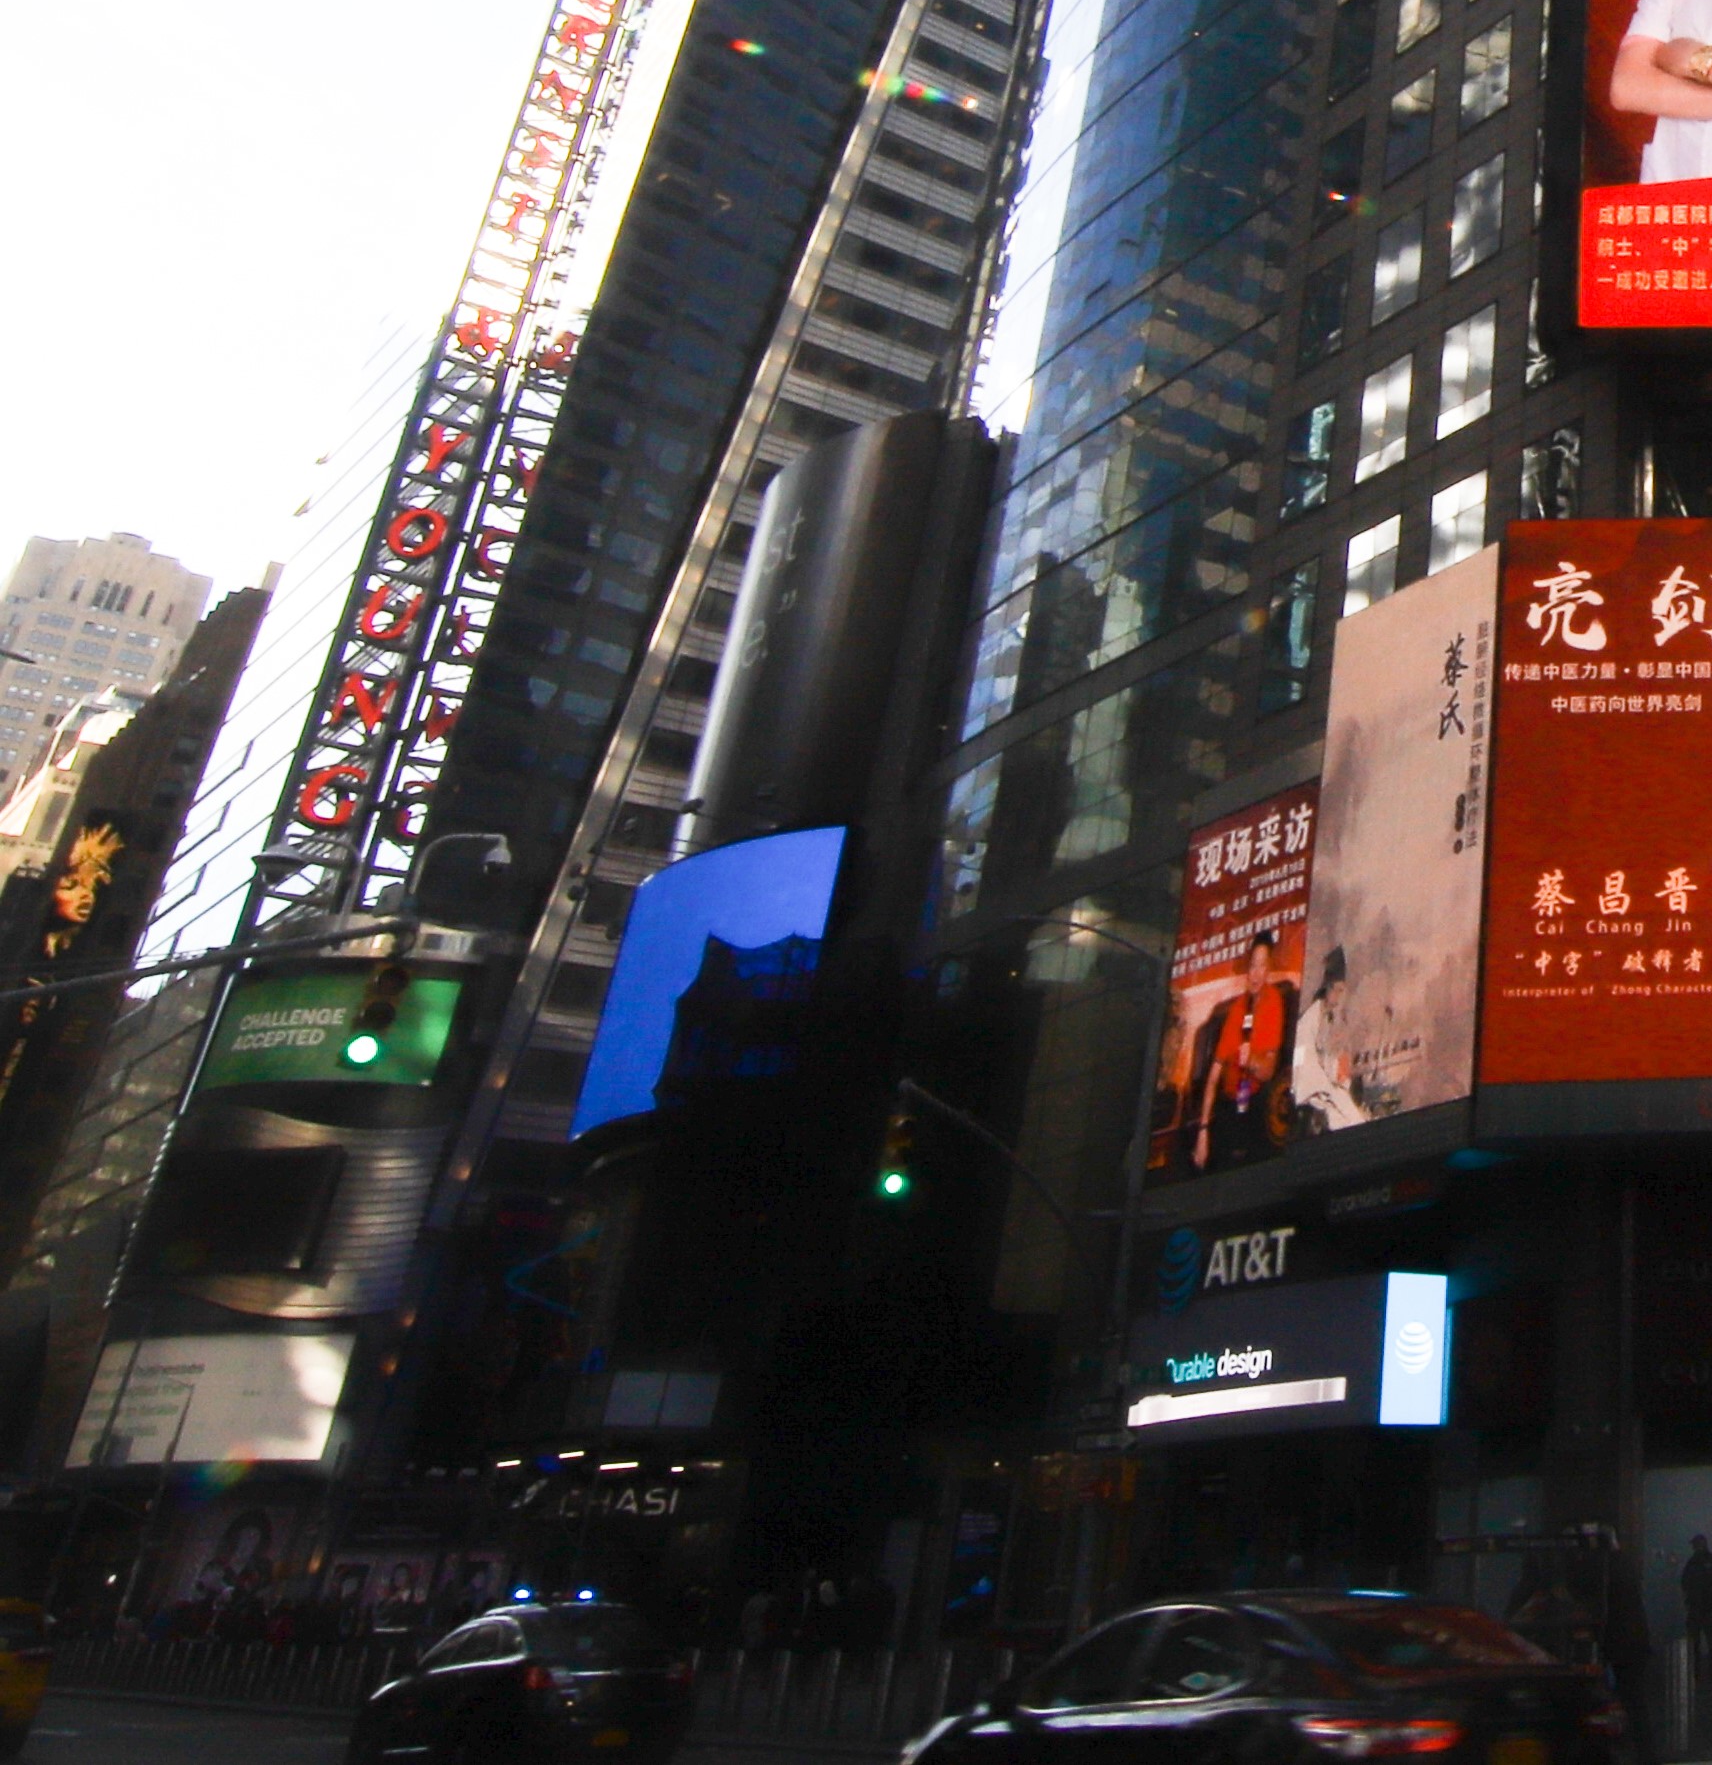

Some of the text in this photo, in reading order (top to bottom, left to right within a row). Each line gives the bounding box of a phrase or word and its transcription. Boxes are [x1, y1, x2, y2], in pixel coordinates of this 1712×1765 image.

[299, 422, 469, 826] YOUNG
[1194, 802, 1313, 887] 现场采访
[1531, 867, 1699, 918] 蔡昌晋
[1535, 918, 1693, 936] Cai Chang Jin
[230, 1028, 326, 1052] ACCEPTED
[240, 1007, 347, 1031] CHALLENGE
[1203, 1225, 1300, 1291] AT&T
[1216, 1345, 1273, 1380] design
